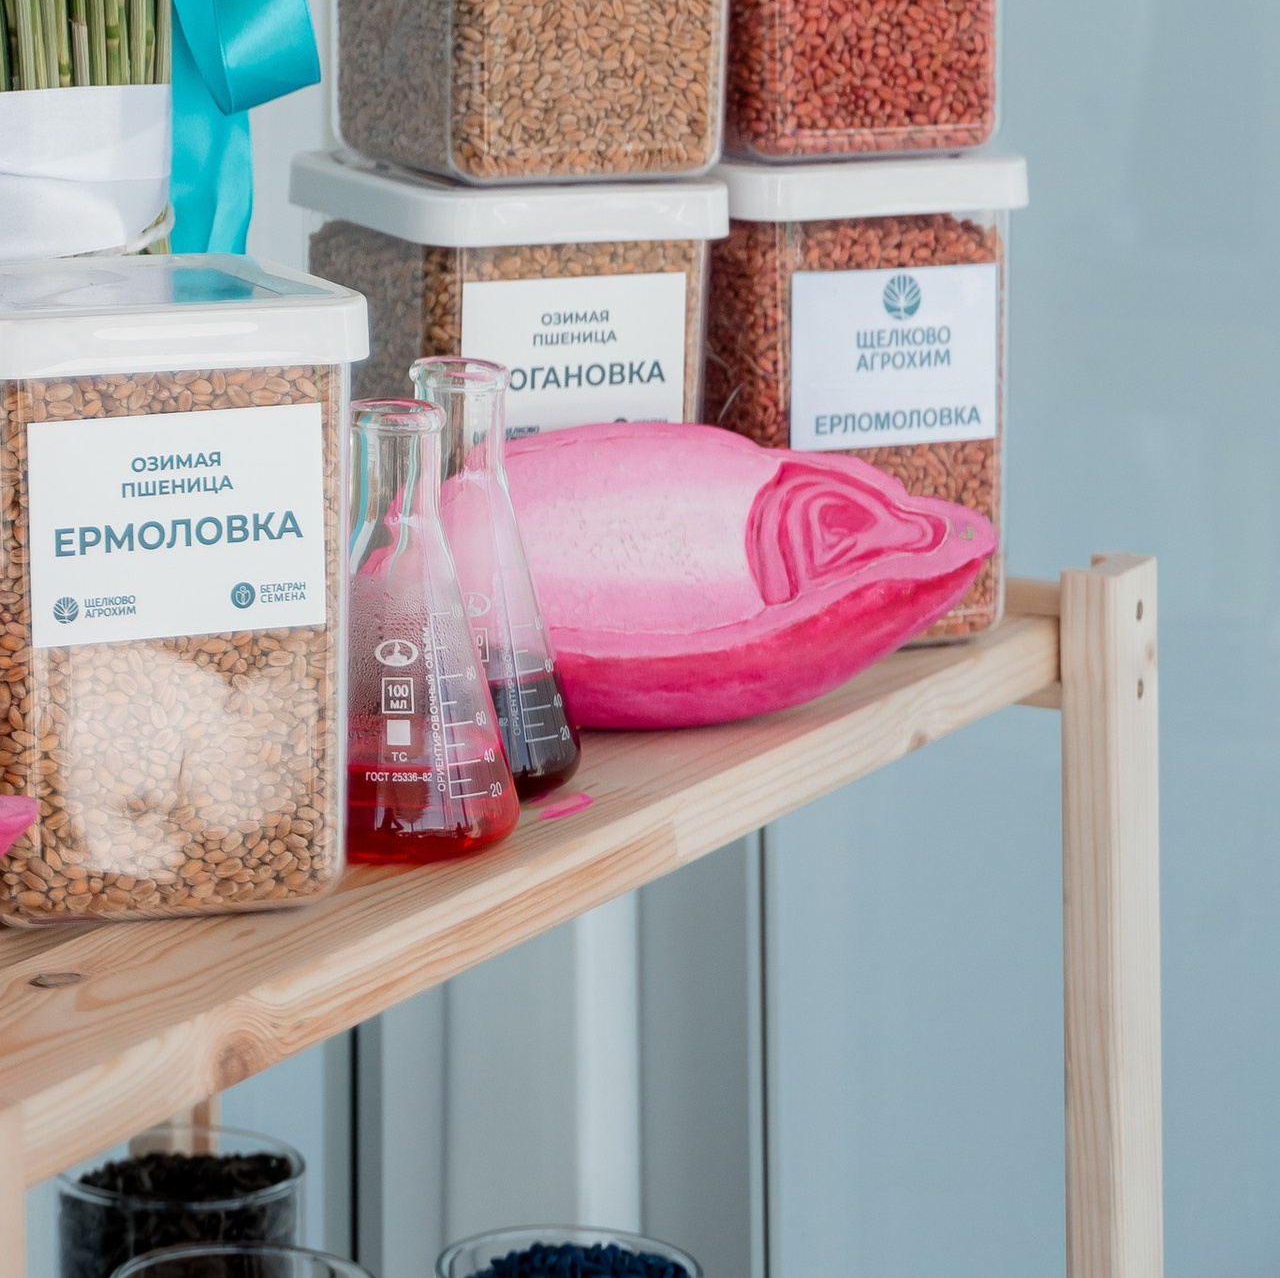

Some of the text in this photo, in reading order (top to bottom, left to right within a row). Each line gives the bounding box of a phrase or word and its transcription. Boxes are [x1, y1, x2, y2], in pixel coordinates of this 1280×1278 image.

[541, 309, 610, 326] ОЗИМАЯ
[532, 329, 617, 347] ПШЕНИЦА
[856, 325, 951, 350] ЩЕЛКОВО
[856, 348, 951, 373] АГРОХИМ
[509, 360, 666, 392] ОГАНОВКА
[814, 405, 982, 436] ЕРЛОМОЛОВКА
[130, 450, 222, 473] ОЗИМАЯ
[121, 474, 234, 499] ПШЕНИЦА
[54, 510, 304, 558] ЕРМОЛОВКА
[260, 581, 307, 594] БЕТАГРАН
[84, 594, 137, 609] ЩЕЛКОВО
[260, 591, 307, 604] СЕМЕНА
[84, 604, 137, 619] АГРОХИМ
[387, 684, 409, 698] 100
[389, 699, 408, 710] МЛ
[553, 693, 563, 708] 40
[475, 710, 487, 726] 60
[425, 674, 447, 792] ОРИЕНТИРОВОЧНЫЙ
[560, 725, 570, 741] 20
[391, 751, 408, 762] ТС
[483, 748, 495, 763] 40
[365, 771, 433, 783] ГОСТ 25336-82
[490, 782, 503, 798] 20
